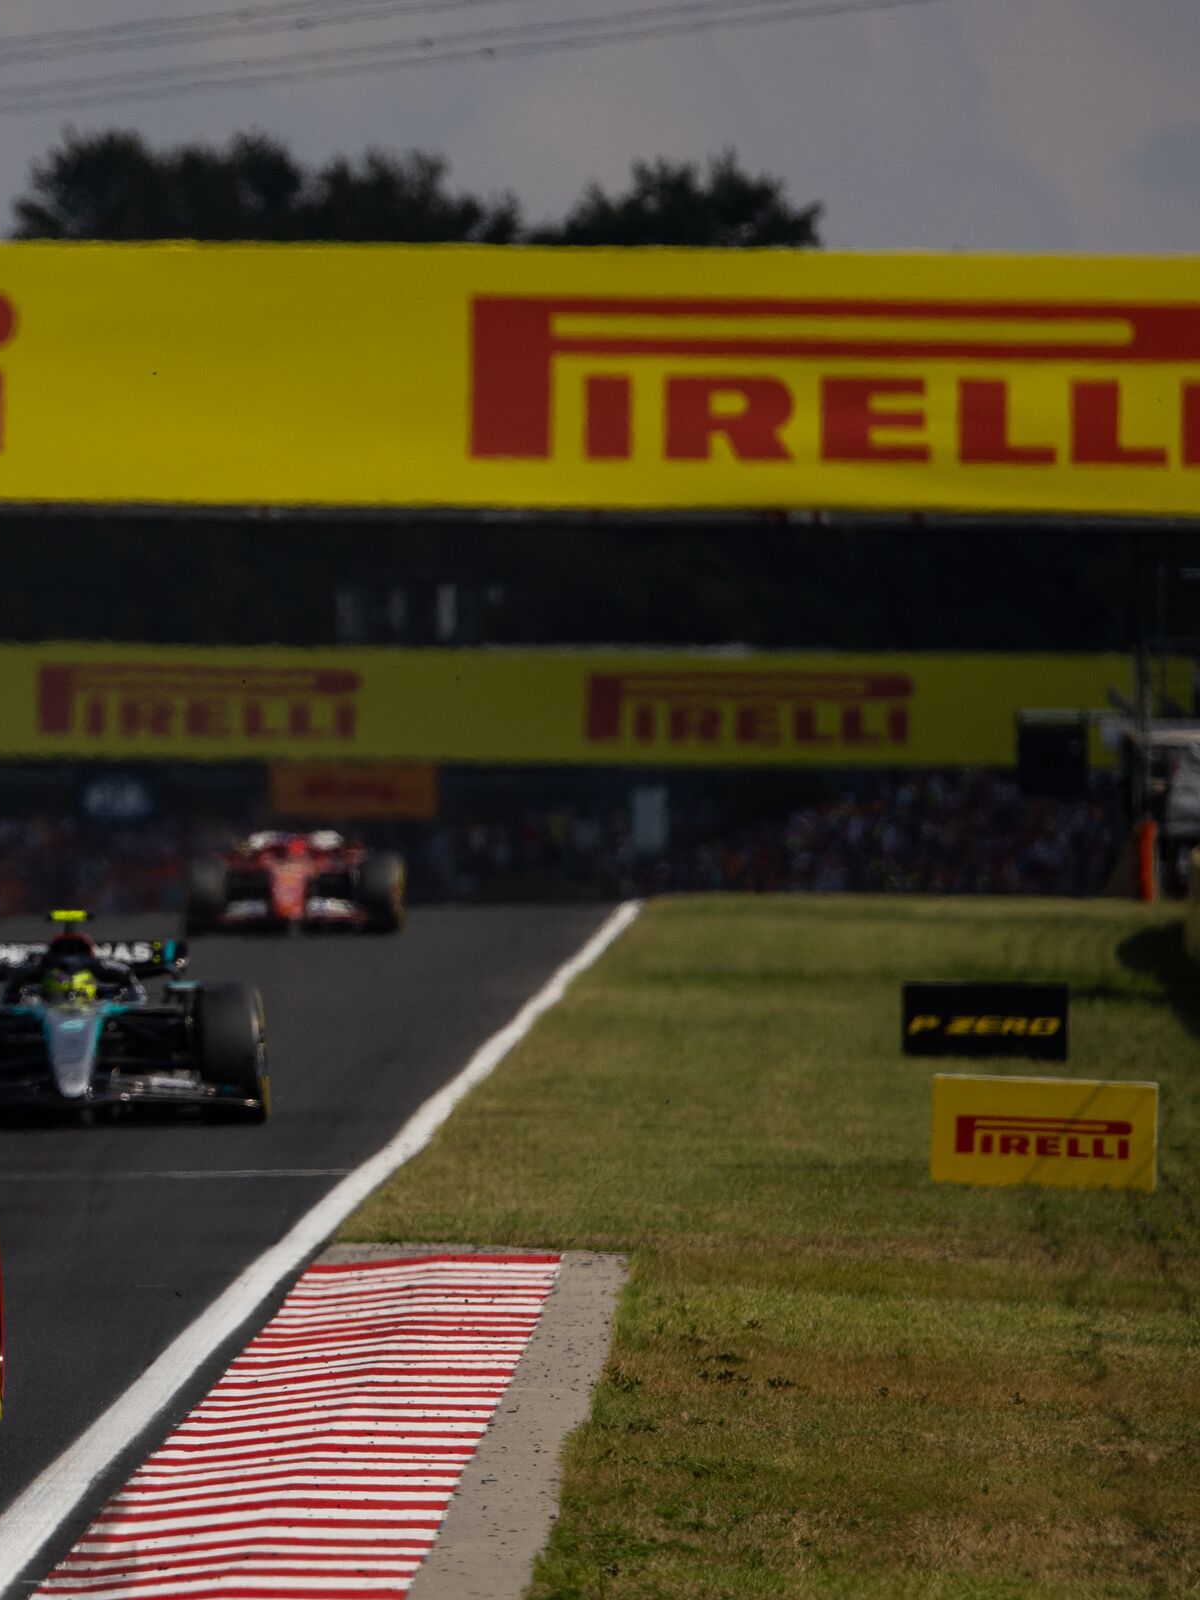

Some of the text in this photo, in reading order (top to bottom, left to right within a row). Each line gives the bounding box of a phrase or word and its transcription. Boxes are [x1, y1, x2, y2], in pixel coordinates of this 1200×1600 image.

[37, 662, 362, 739] PIRELLI
[585, 670, 915, 743] PIRELLI
[907, 1014, 1061, 1036] P ZERO
[954, 1114, 1134, 1161] PIRELLI
